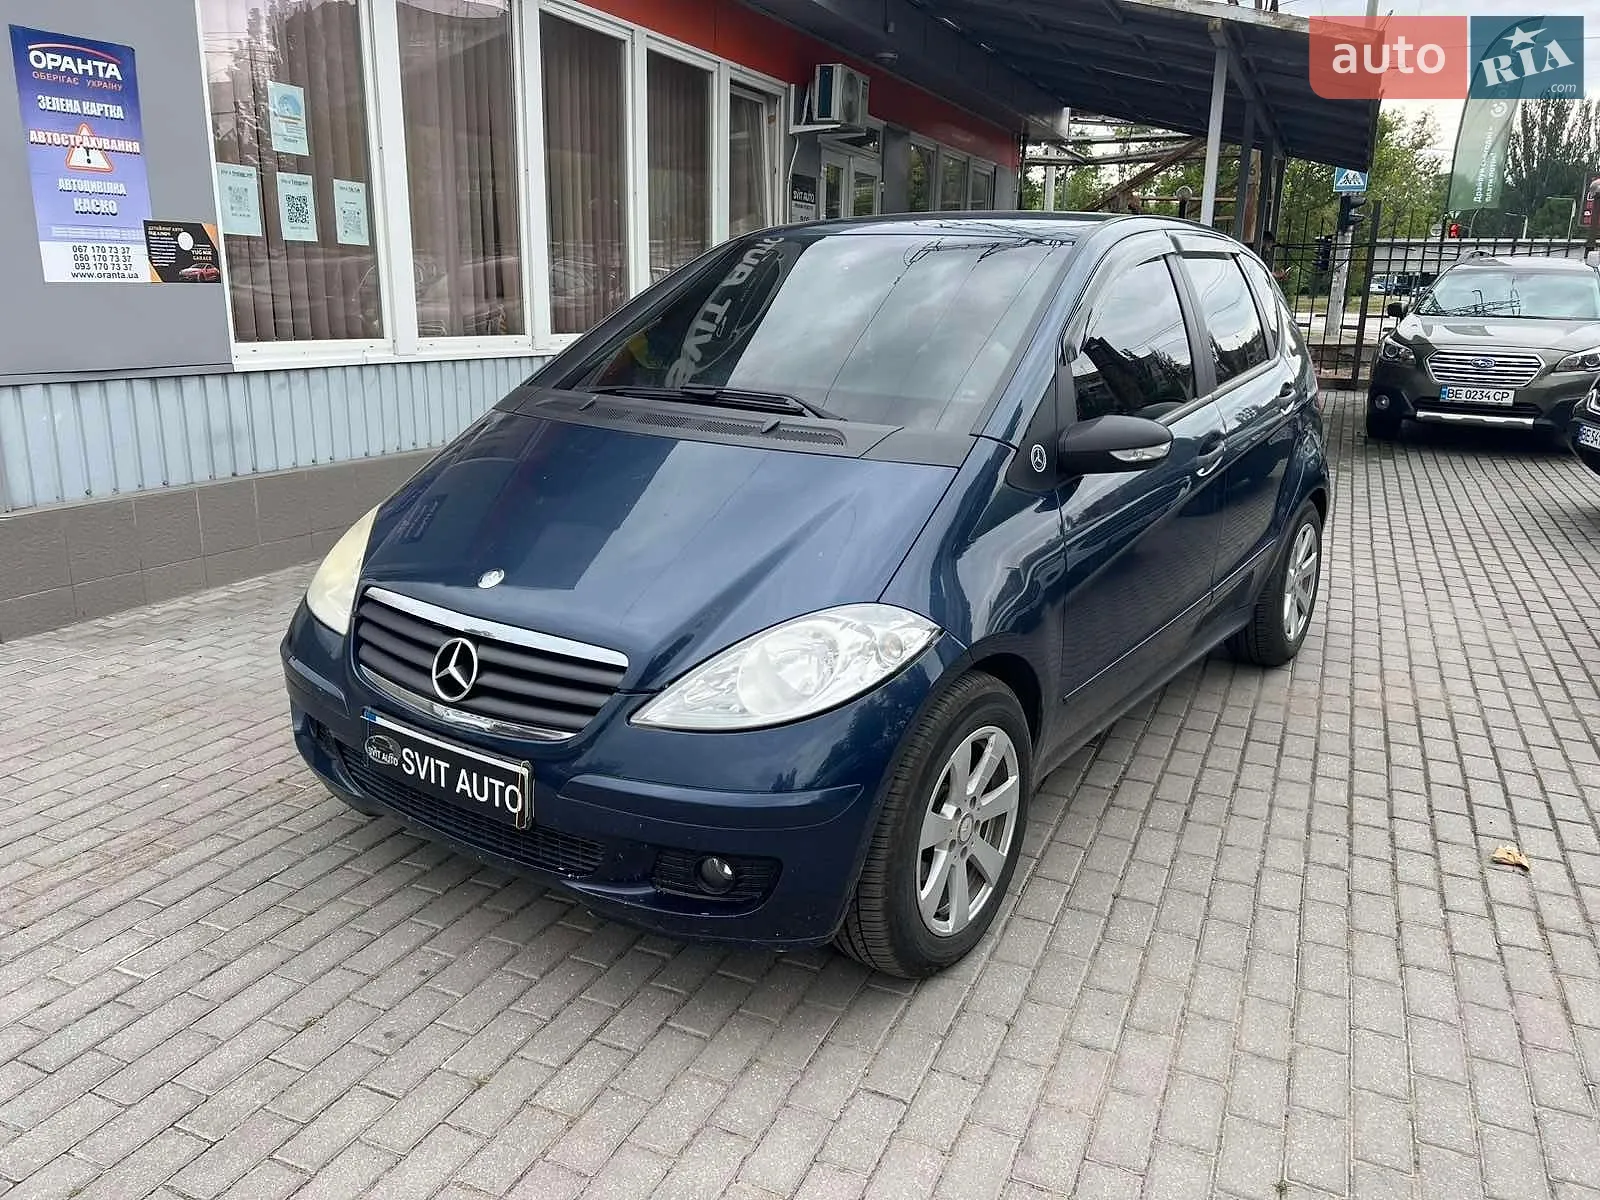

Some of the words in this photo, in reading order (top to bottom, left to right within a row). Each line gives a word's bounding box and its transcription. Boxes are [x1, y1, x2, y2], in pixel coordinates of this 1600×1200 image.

[29, 50, 122, 80] ОРАНТА
[32, 71, 79, 85] ОБЕРІГАЄ
[86, 80, 123, 91] УКРАЇНУ
[37, 94, 82, 114] ЗЕЛЕНА
[83, 101, 124, 119] КАРТКА
[29, 130, 140, 154] АВТОСТРАХУВАННЯ
[57, 178, 127, 196] АВТОЦИВІЛКА
[74, 198, 118, 215] КАСКО
[72, 245, 88, 254] 067
[91, 245, 106, 254] 170
[108, 246, 119, 254] 73
[120, 246, 131, 255] 37
[73, 253, 90, 262] 050
[92, 254, 107, 262] 170
[109, 254, 120, 263] 73
[121, 255, 132, 263] 37
[71, 270, 139, 279] www.oranta.ua
[74, 262, 91, 271] 093
[93, 262, 108, 271] 170
[110, 263, 121, 271] 73
[122, 263, 133, 271] 37
[1447, 387, 1463, 400] BE
[1465, 388, 1491, 400] 0234
[1493, 391, 1510, 401] CP
[382, 752, 399, 767] AUTO
[401, 747, 450, 788] SVIT
[455, 768, 523, 814] AUTO
